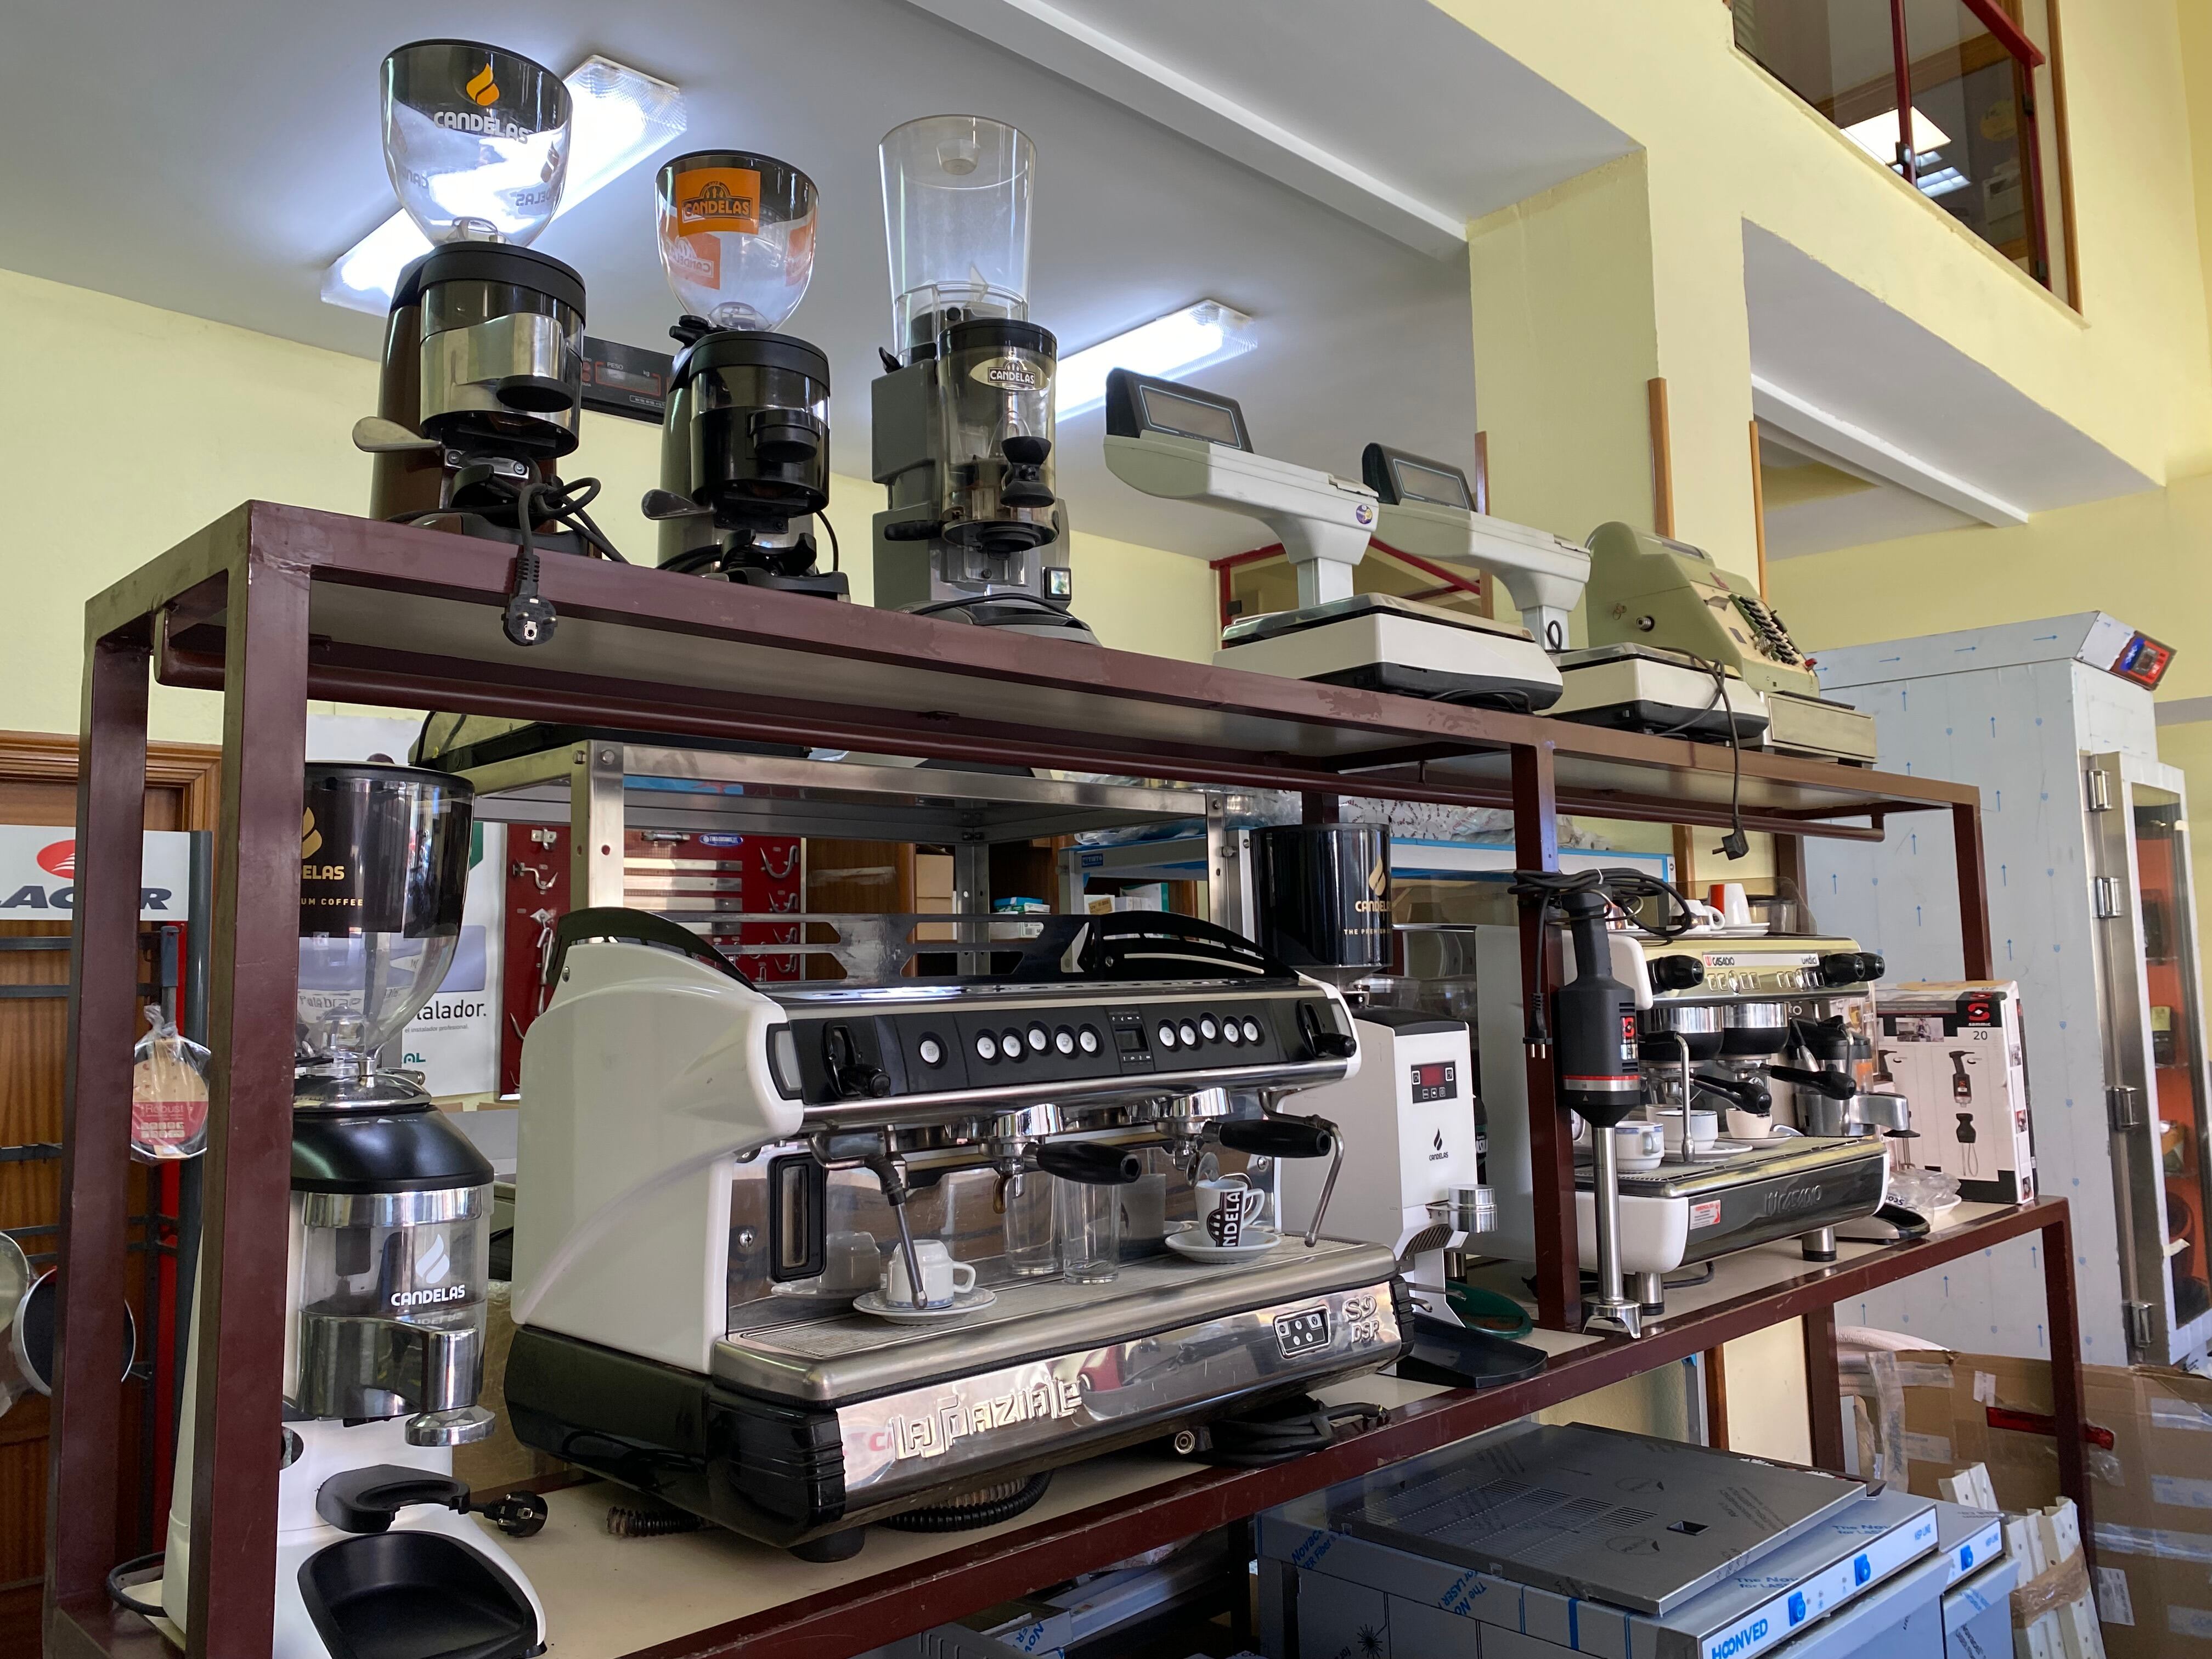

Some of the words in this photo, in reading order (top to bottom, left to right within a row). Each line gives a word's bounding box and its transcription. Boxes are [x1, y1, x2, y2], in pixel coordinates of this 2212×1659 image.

[433, 111, 528, 144] CANDELAS
[685, 201, 749, 216] CANDELAS
[990, 370, 1035, 384] CANDELAS
[302, 865, 345, 880] ELAS
[0, 885, 172, 910] ACR
[1973, 1031, 1988, 1040] 20
[403, 1053, 426, 1064] AL
[1429, 1152, 1449, 1161] CANDELAS
[1222, 1192, 1241, 1246] NDELA
[391, 1285, 465, 1307] CANDELAS
[1344, 1295, 1377, 1321] S9
[1352, 1320, 1379, 1343] DSP
